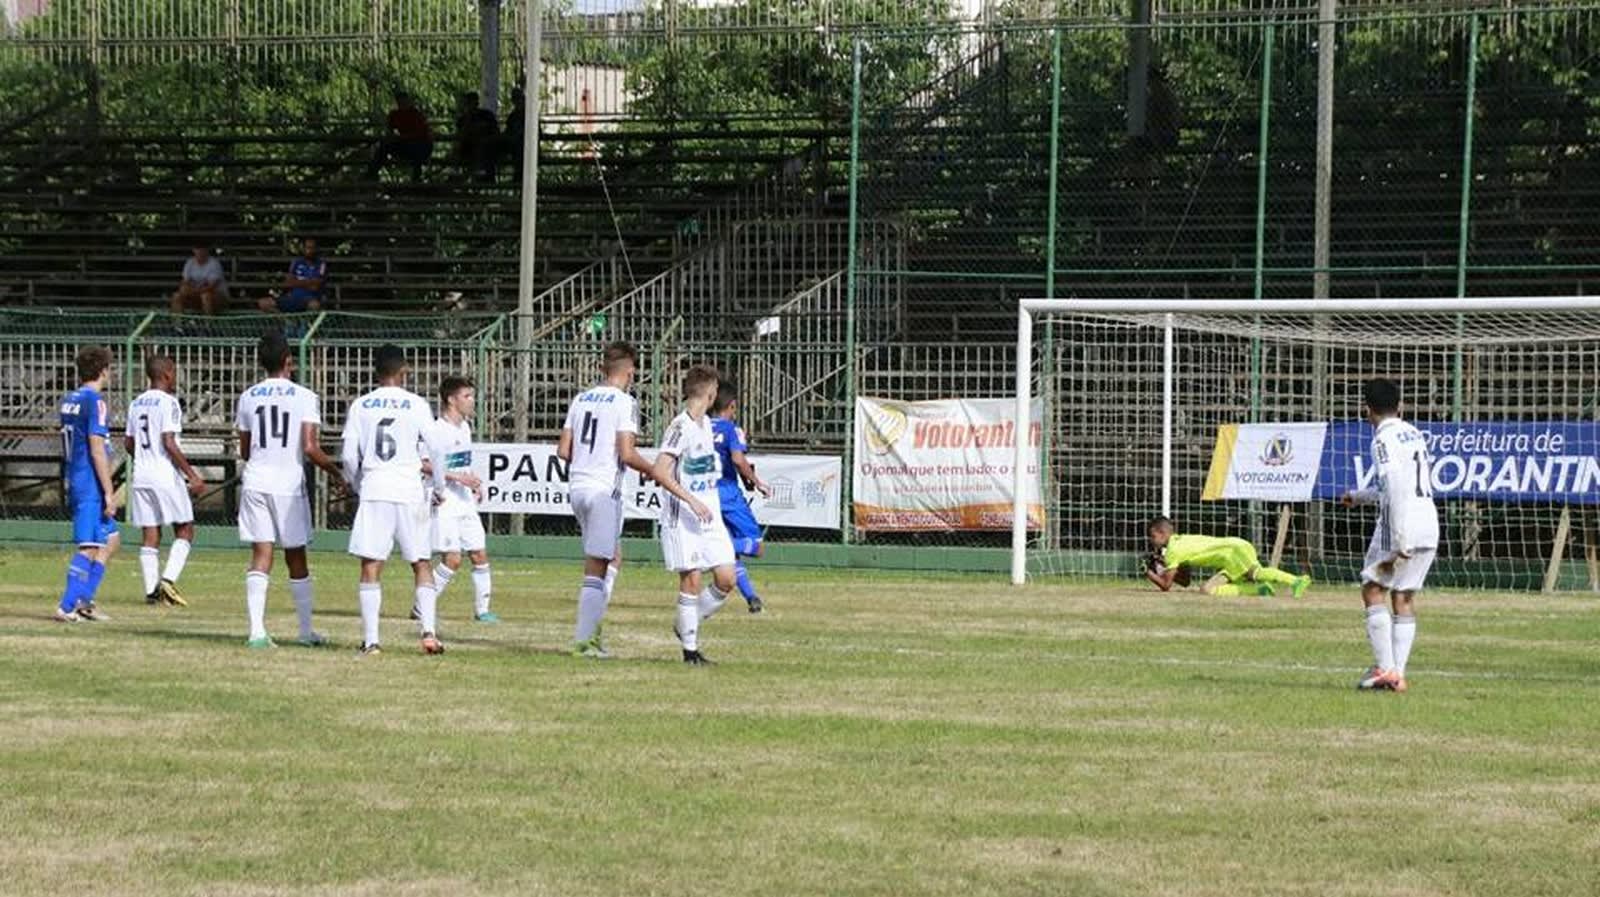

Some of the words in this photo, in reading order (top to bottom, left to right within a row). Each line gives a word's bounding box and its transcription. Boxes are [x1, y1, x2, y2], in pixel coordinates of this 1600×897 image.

[139, 414, 151, 449] 3
[255, 405, 290, 449] 14
[375, 417, 397, 462] 6
[580, 411, 598, 454] 4
[1419, 427, 1529, 453] Prefeitura
[1533, 427, 1564, 453] de
[488, 453, 570, 483] PAN
[1233, 471, 1310, 484] VOTORANTIM
[487, 486, 571, 504] Premia
